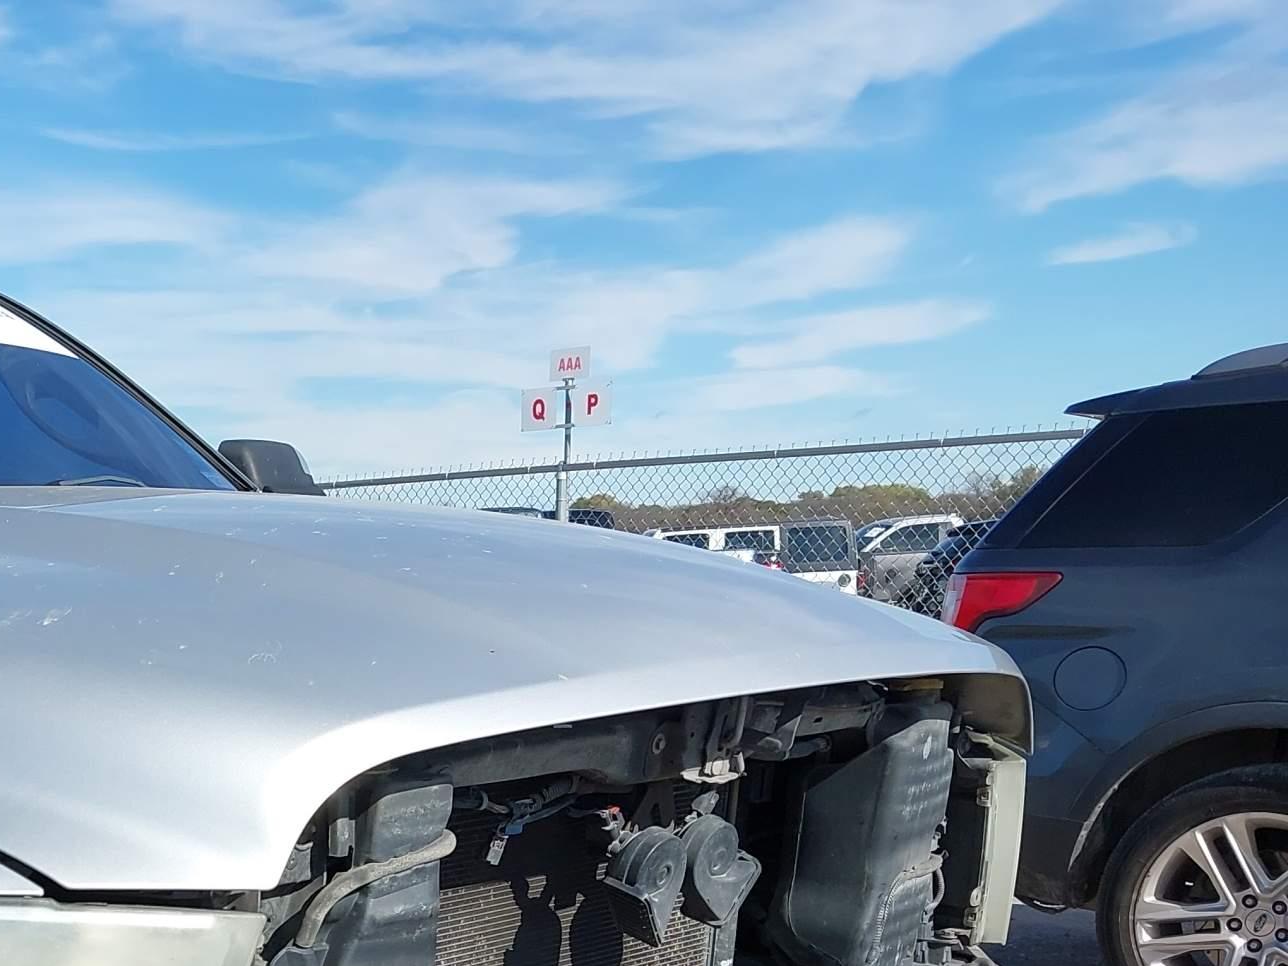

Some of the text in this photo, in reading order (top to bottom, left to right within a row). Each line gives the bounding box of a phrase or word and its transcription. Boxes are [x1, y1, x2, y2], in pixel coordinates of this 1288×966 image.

[558, 356, 582, 372] AAA
[532, 398, 546, 421] Q
[586, 393, 599, 415] P
